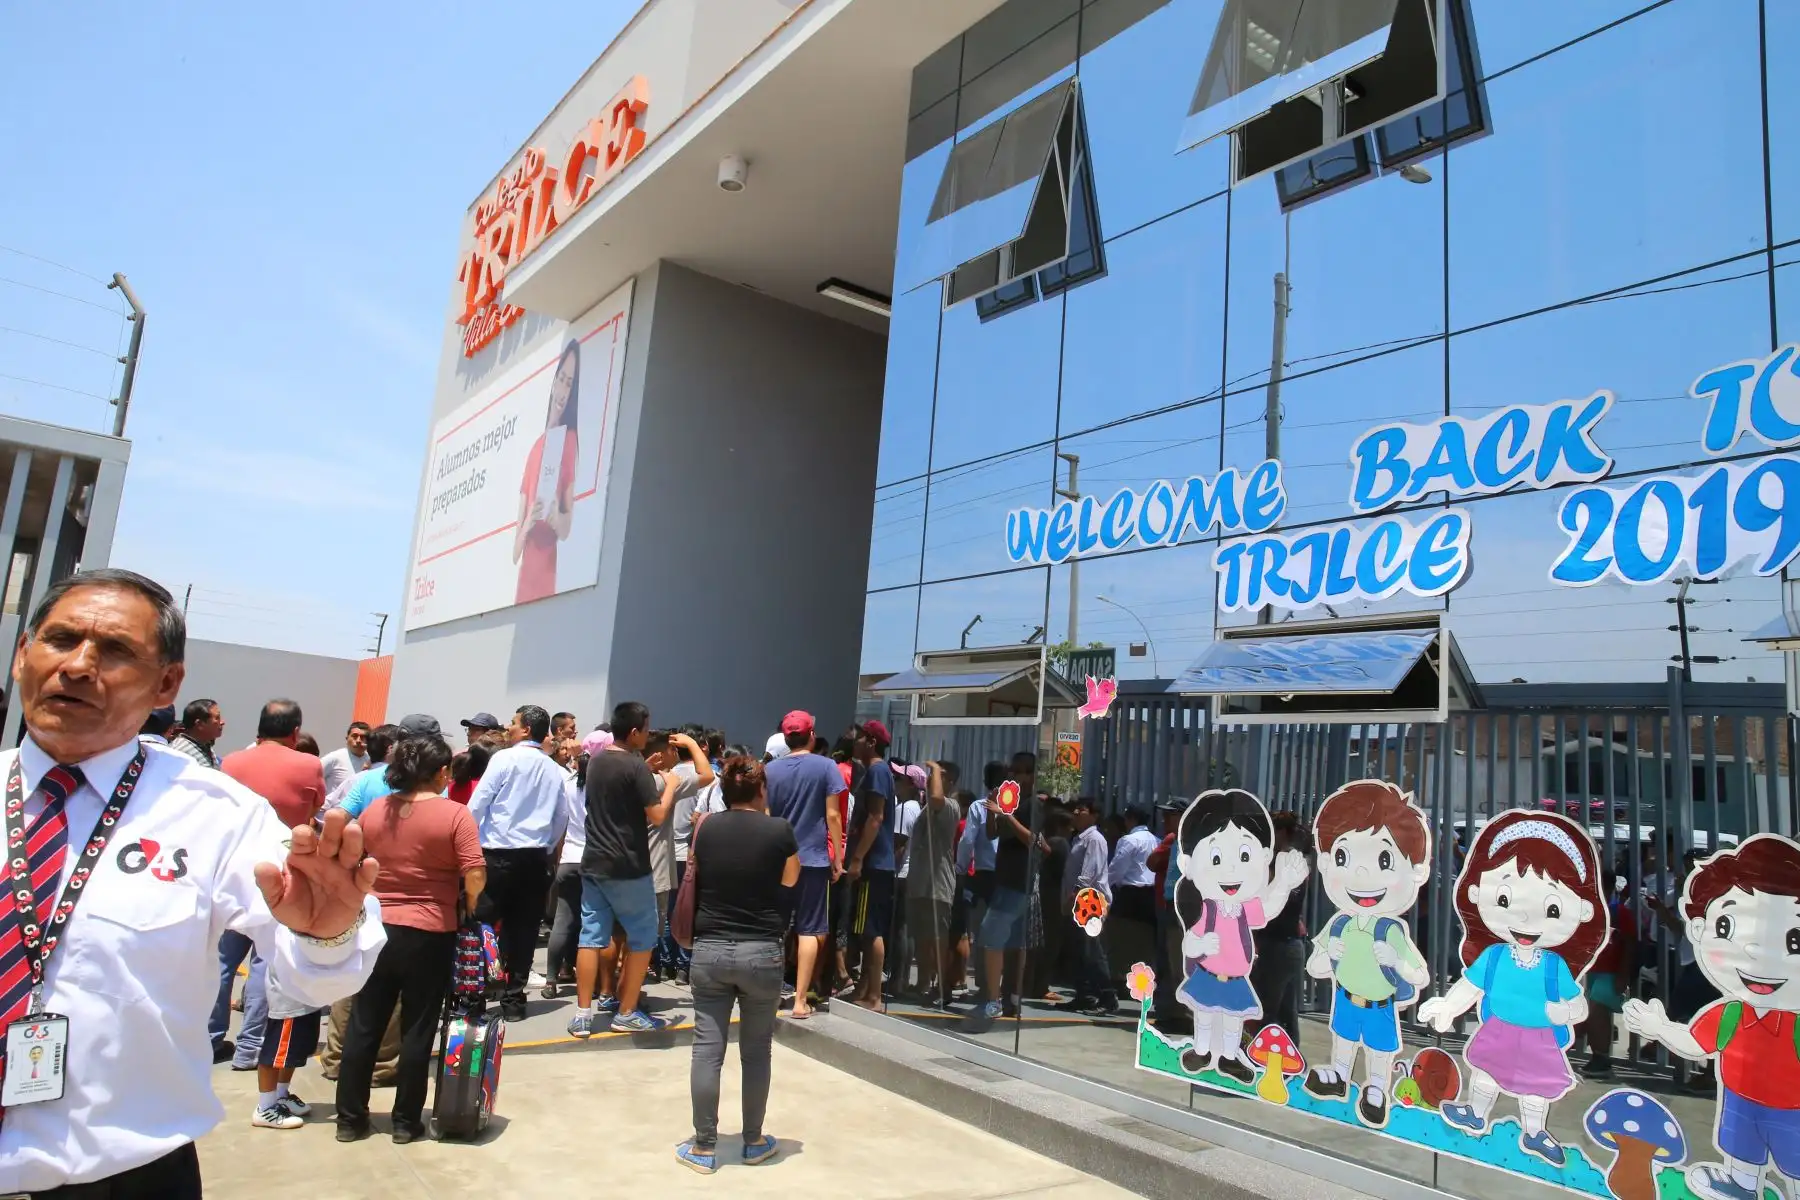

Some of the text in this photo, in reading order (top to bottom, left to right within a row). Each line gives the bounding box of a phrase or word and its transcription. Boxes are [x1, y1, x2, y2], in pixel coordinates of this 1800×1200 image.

[457, 73, 648, 324] TRILCE
[437, 415, 518, 481] Alumnos mejor
[1008, 461, 1285, 562] WELCOME
[1355, 395, 1612, 509] BACK
[430, 467, 487, 521] preparados
[1551, 458, 1800, 583] 2019
[116, 837, 189, 882] G4S
[23, 1023, 50, 1040] G4S
